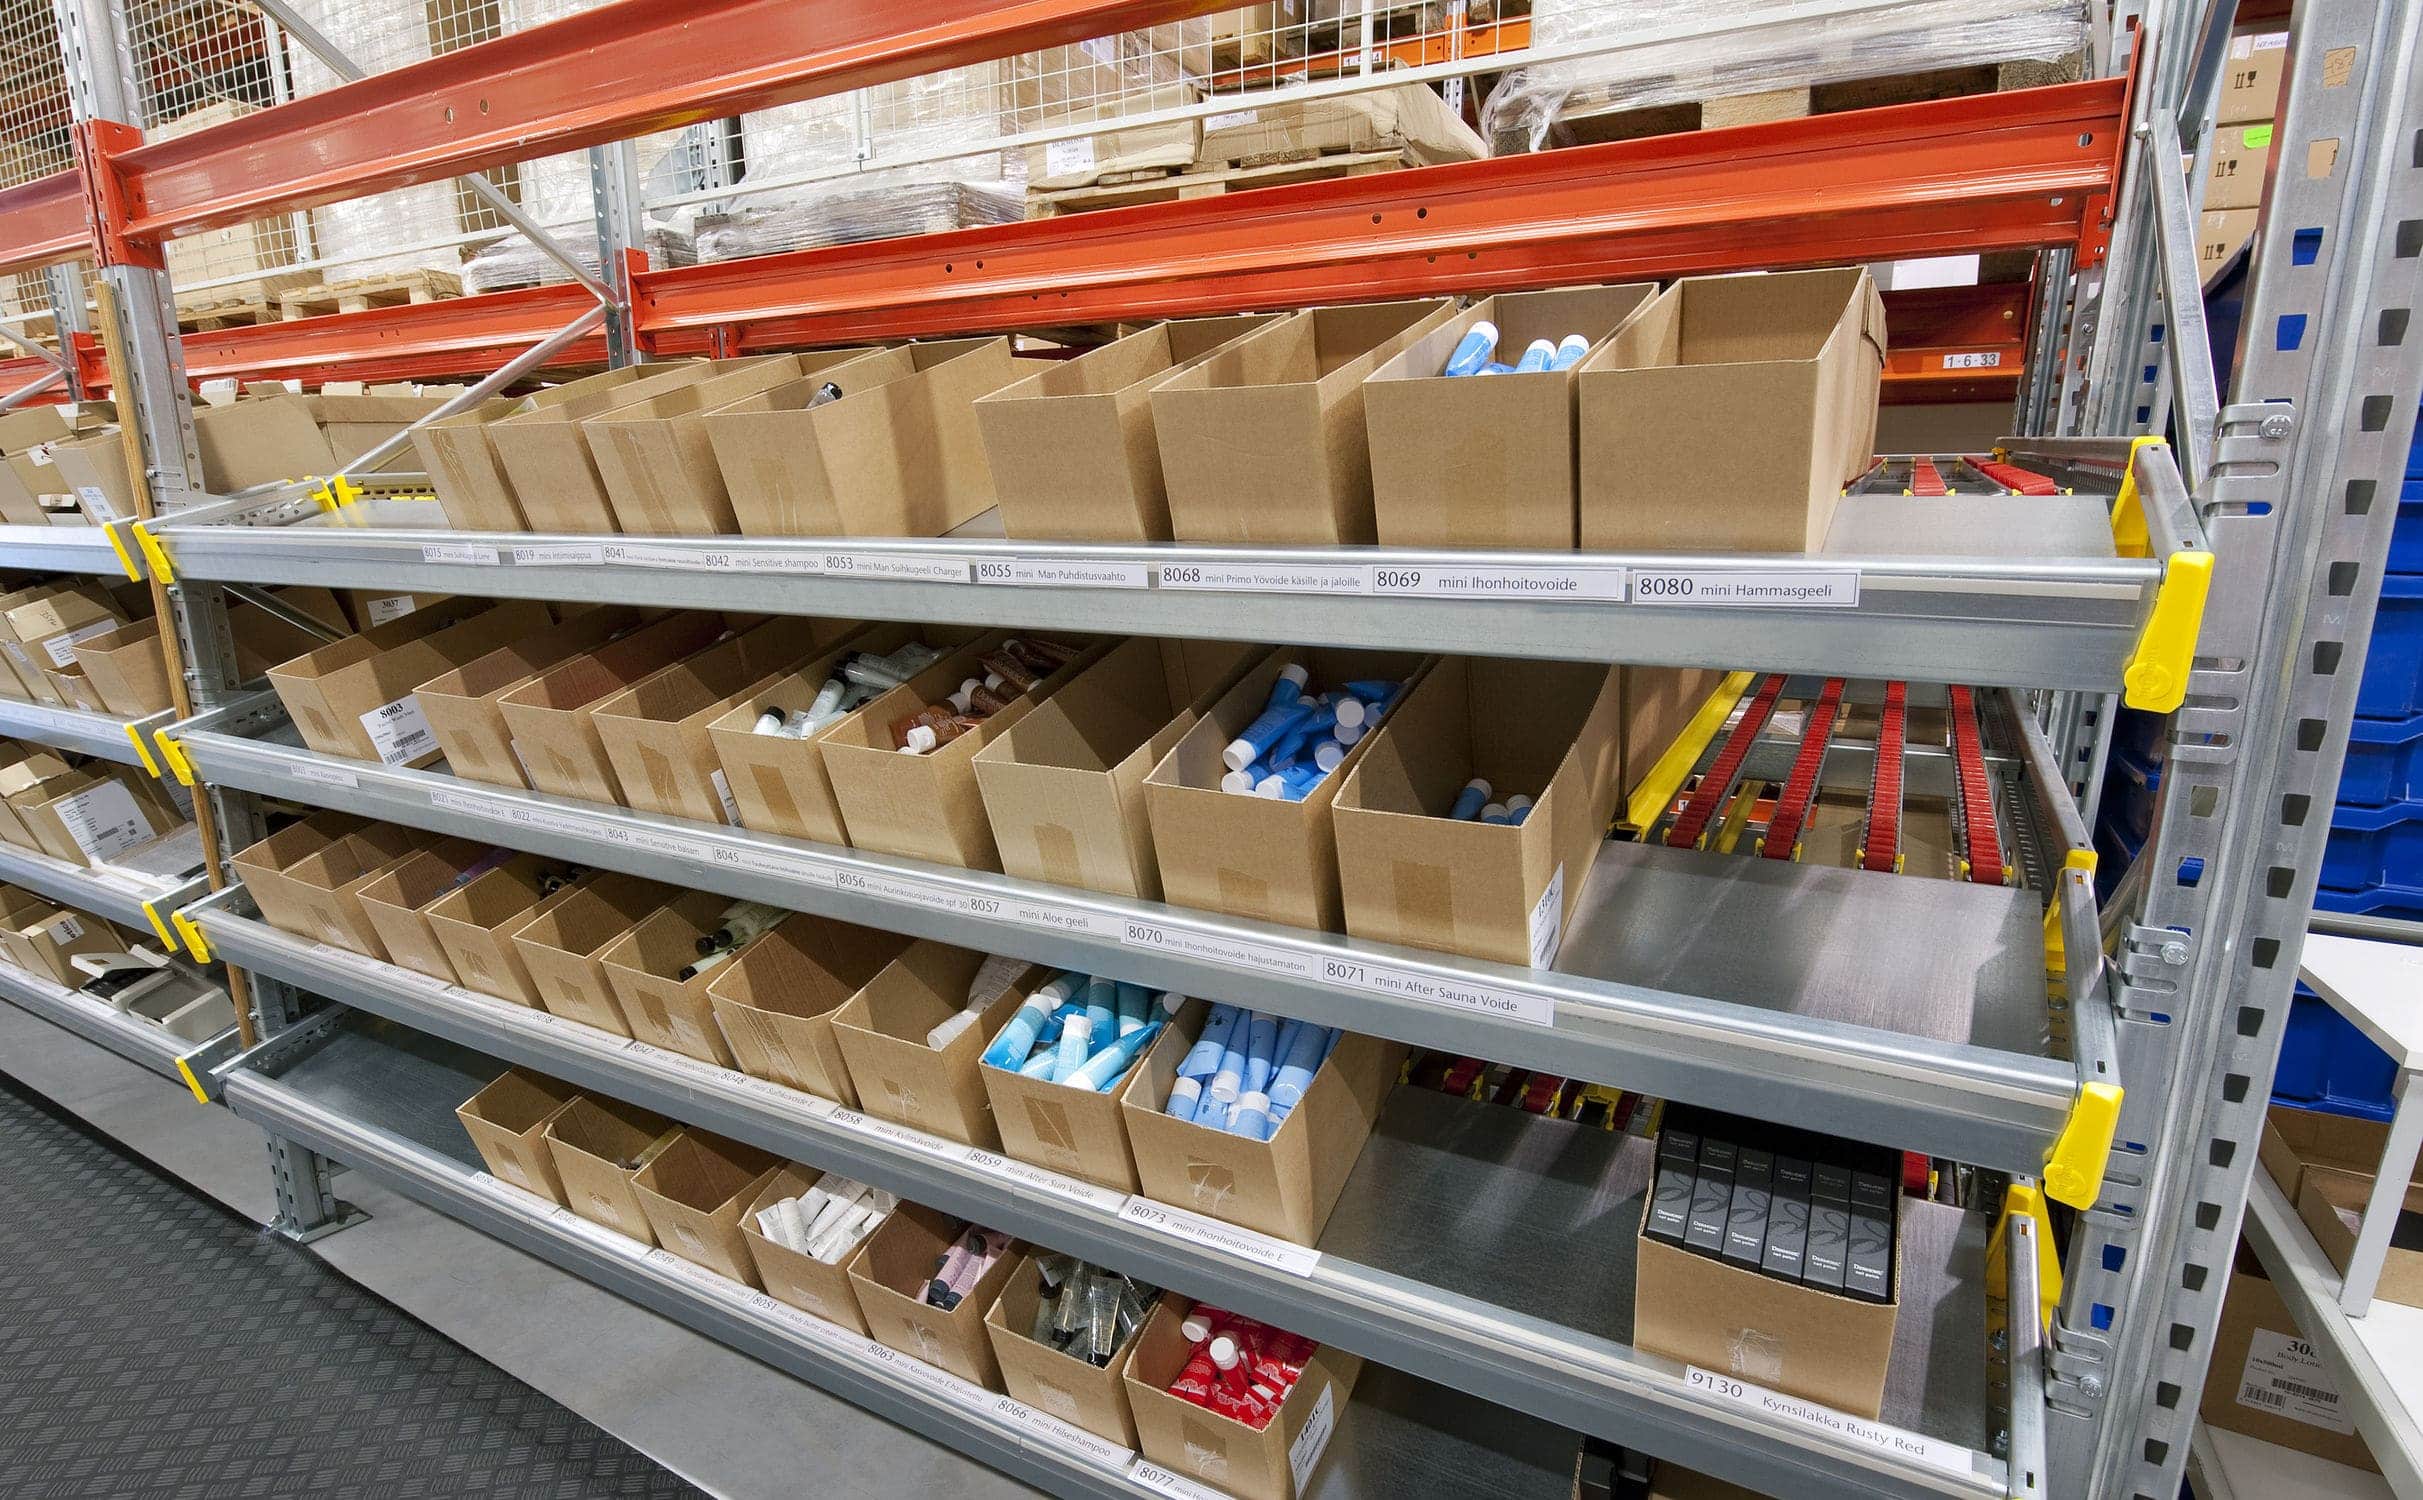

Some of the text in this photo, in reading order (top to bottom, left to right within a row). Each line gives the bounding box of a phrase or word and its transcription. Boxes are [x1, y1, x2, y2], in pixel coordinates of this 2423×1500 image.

[516, 549, 535, 561] 8019
[605, 547, 626, 560] 8041
[706, 555, 730, 567] 8042
[735, 559, 751, 567] mini
[752, 557, 783, 567] Sensitive
[785, 558, 819, 570] shampoo
[825, 556, 854, 570] 8053
[857, 563, 874, 571] mini
[874, 562, 891, 572] Man
[934, 567, 963, 578] Charger
[981, 564, 1126, 582] 8055 mini Man Puhdistusvaahto
[1163, 567, 1201, 582] 8068
[1205, 574, 1224, 583] mini
[1320, 575, 1329, 588] ja
[1331, 575, 1361, 588] jaloille
[1377, 571, 1577, 592] 8069 mini Ihonhoitovoide
[1640, 578, 1833, 600] 8080 mini Hammasgeeli
[379, 703, 405, 719] 8003
[512, 809, 531, 822] 8022
[607, 828, 629, 842] 8043
[716, 850, 740, 863] 8045
[838, 872, 866, 889] 8056
[946, 896, 958, 908] spf
[970, 894, 1089, 929] 8057 mini Aloe geeli
[1128, 925, 1306, 973] 8070 mini Ihonhoitovoide hajustamaton
[1326, 962, 1519, 1012] 8071 mini After Sauna Voide
[720, 1072, 747, 1087] 8048
[834, 1109, 863, 1126] 8058
[874, 1125, 893, 1137] mini
[970, 1151, 1095, 1200] 8059 mini After Sun Voide
[1131, 1204, 1286, 1263] 8073 mini Ihonhoitovoide E
[753, 1296, 779, 1312] 8051
[867, 1343, 896, 1362] 8063
[997, 1399, 1028, 1420] 8066
[1031, 1415, 1052, 1431] mini
[1691, 1372, 1926, 1457] 9130 Kynsilakka Rusty Red
[1139, 1466, 1175, 1488] 8077
[1174, 1485, 1193, 1498] mini
